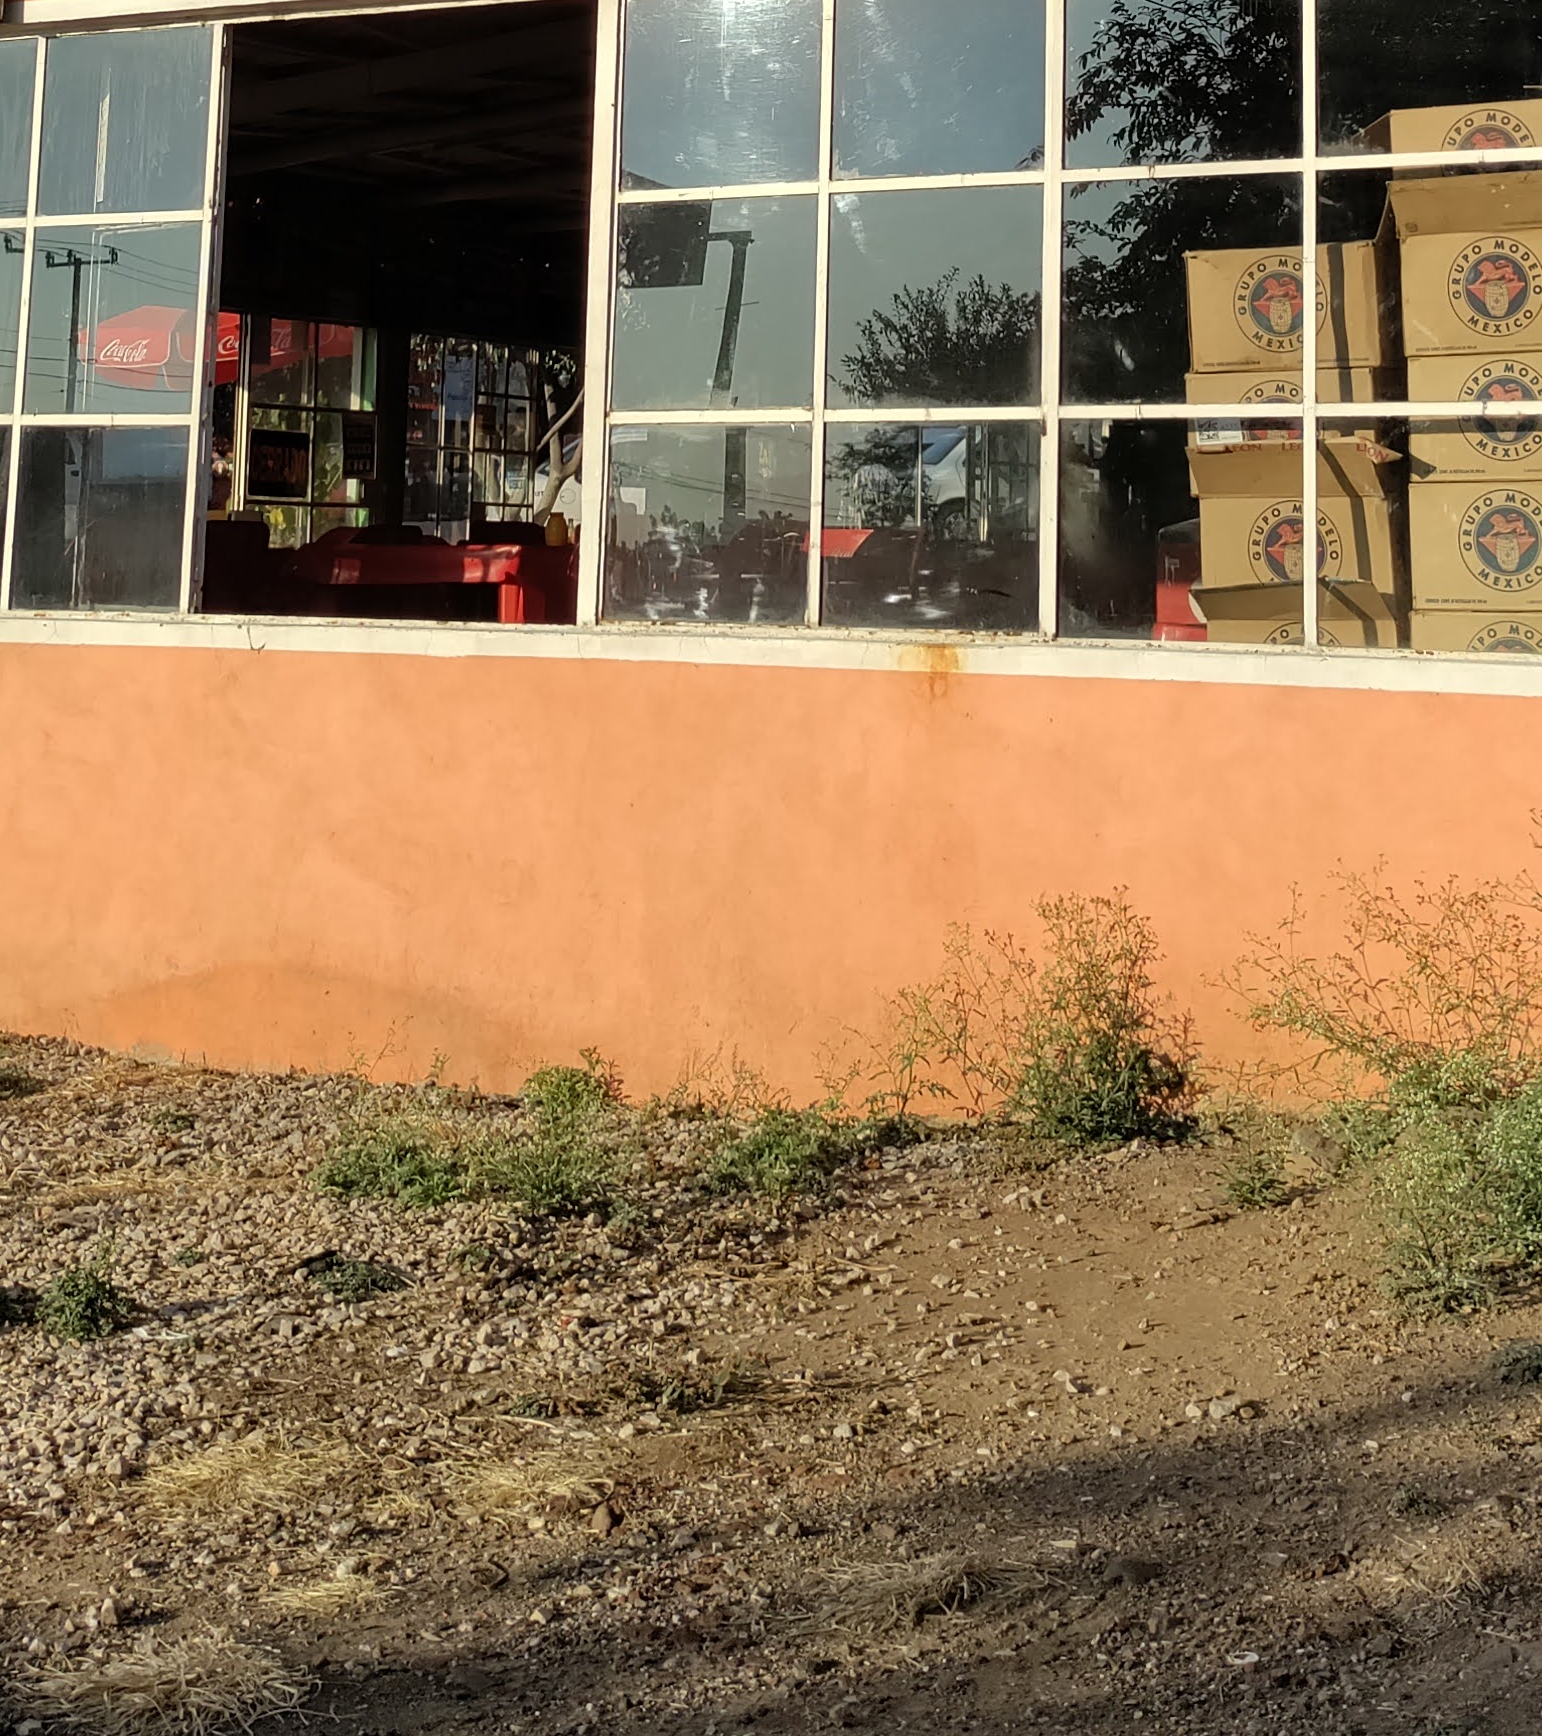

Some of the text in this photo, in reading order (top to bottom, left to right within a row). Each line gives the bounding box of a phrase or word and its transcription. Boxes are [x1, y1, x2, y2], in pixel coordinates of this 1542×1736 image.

[1447, 112, 1532, 148] UPO MODE
[1238, 258, 1324, 315] GRUPO MOLO
[1452, 240, 1542, 300] GRUPO MODELO
[1252, 330, 1303, 349] MEXIC
[1467, 309, 1534, 334] MEXICO
[1463, 368, 1492, 404] UPO
[1476, 435, 1542, 458] MEXICO
[1252, 504, 1339, 560] GRUPO MDELO
[1463, 496, 1493, 552] GRUPO
